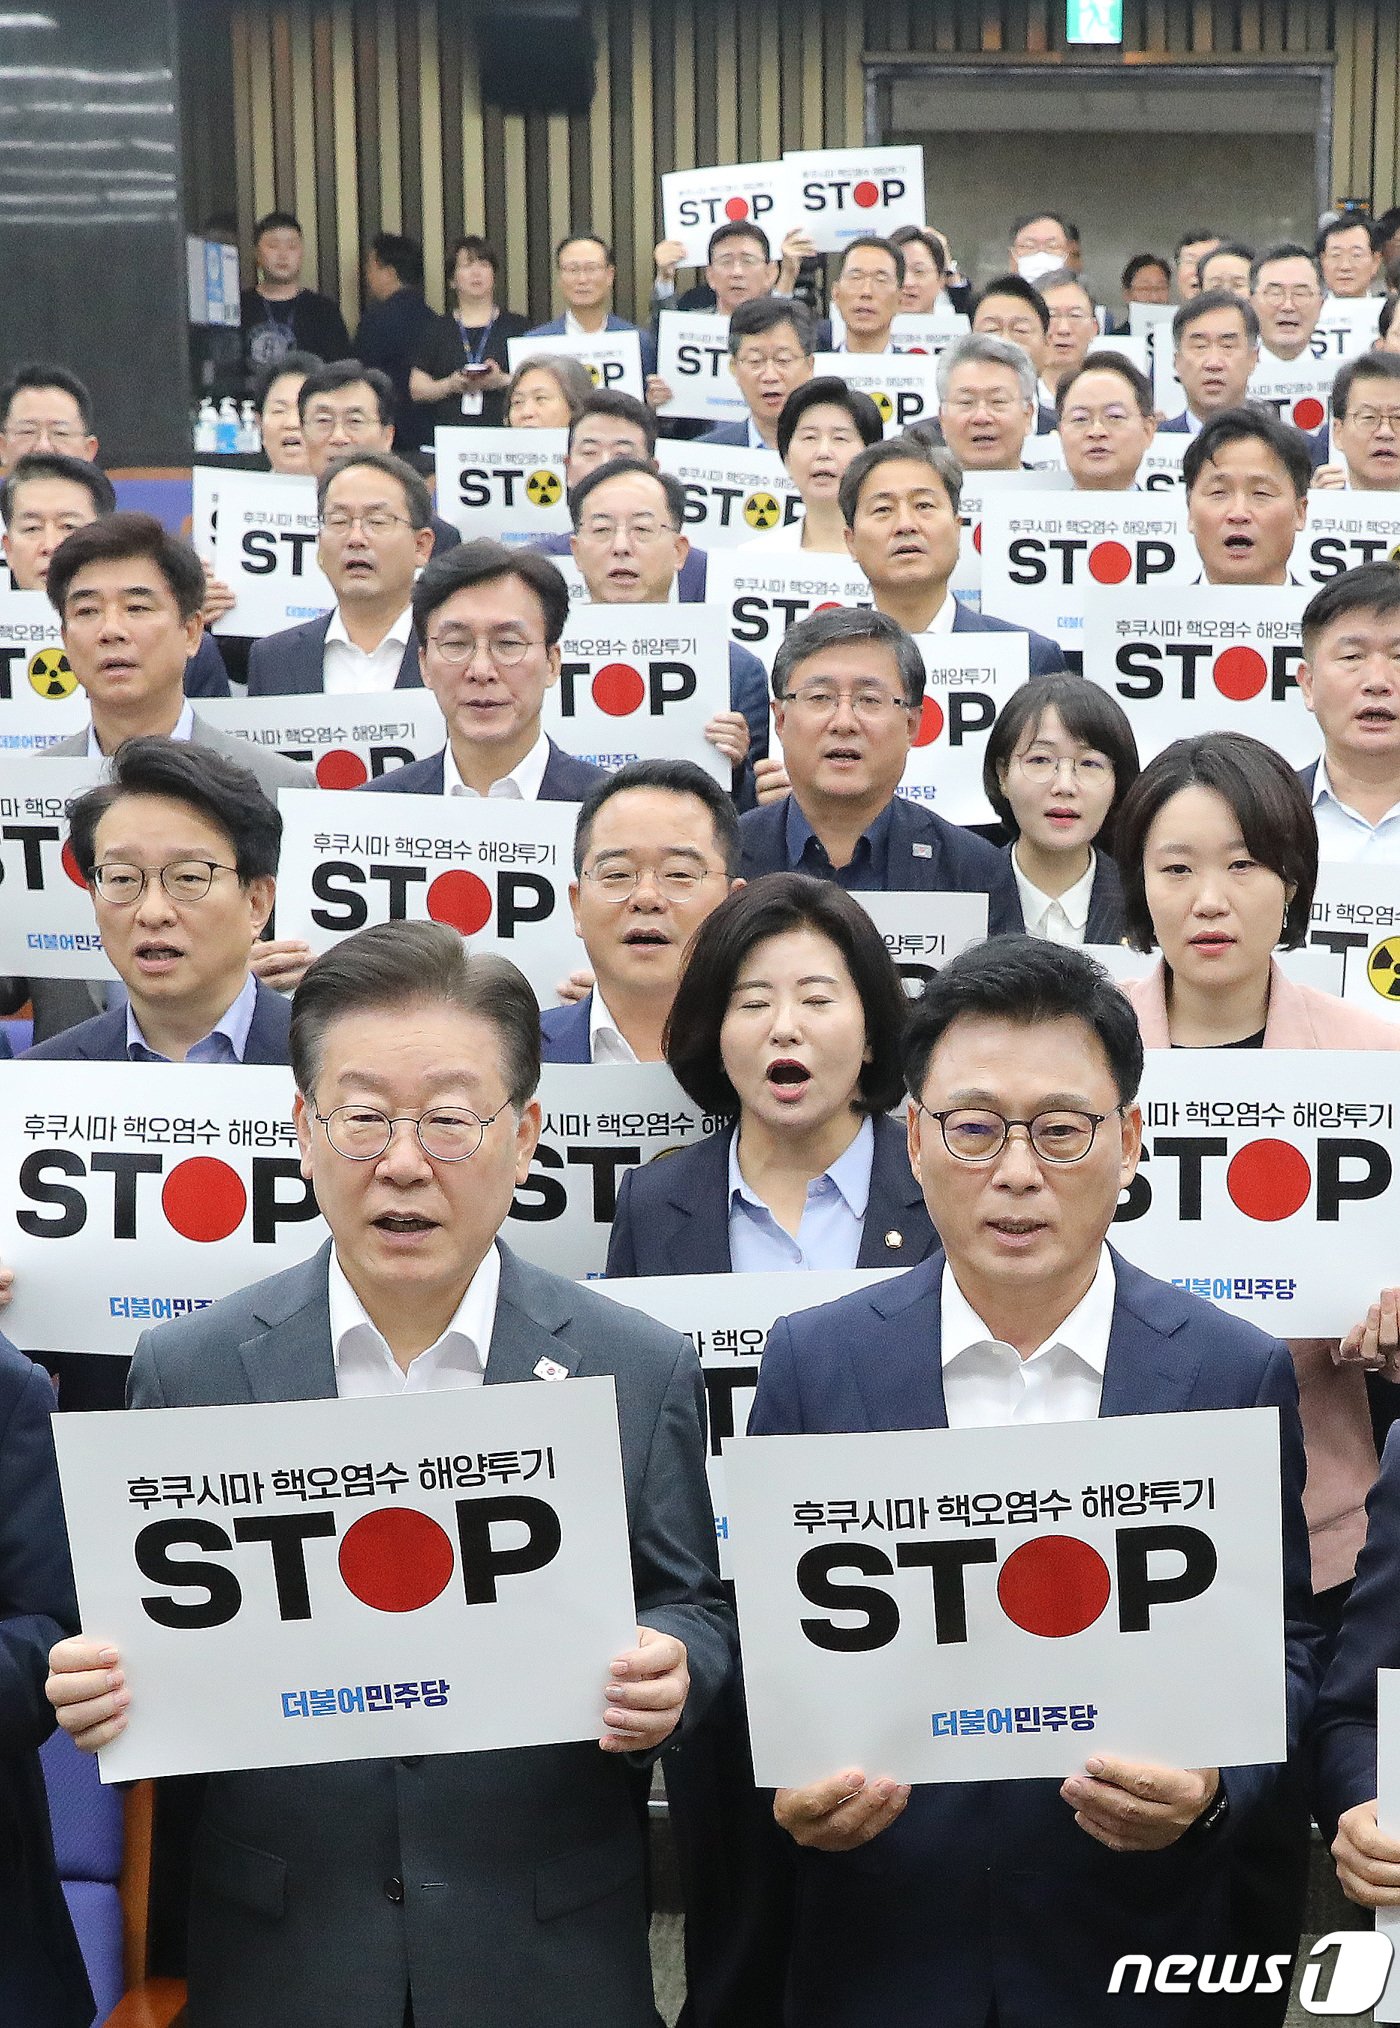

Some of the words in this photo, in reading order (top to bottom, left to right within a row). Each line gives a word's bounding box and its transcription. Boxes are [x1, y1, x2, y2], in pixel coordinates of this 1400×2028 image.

[680, 194, 774, 226] STOP
[803, 179, 905, 210] STOP
[1009, 539, 1175, 584] STOP
[632, 638, 697, 656] 해양투기
[1115, 620, 1181, 637] 후쿠시마
[1186, 620, 1251, 638] 핵오염수
[1256, 621, 1302, 639] 해양투
[931, 667, 997, 686] 해양투기
[1115, 642, 1304, 701] STOP
[561, 662, 697, 717] TOP
[313, 832, 390, 857] 후쿠시마
[395, 836, 473, 861] 핵오염수
[478, 840, 556, 866] 해양투기
[311, 861, 555, 939] STOP
[883, 933, 945, 955] 양투기
[24, 1114, 117, 1142] 후쿠시마
[123, 1116, 221, 1145] 핵오염수
[228, 1118, 300, 1148] 해양투
[542, 1112, 591, 1138] 시마
[597, 1112, 694, 1138] 핵오염수
[1186, 1101, 1285, 1128] 핵오염수
[1293, 1102, 1393, 1129] 해양투기
[16, 1149, 322, 1244] STOP
[127, 1476, 265, 1511] 후쿠시마
[271, 1462, 410, 1501] 핵오염수
[418, 1446, 555, 1491] 해양투기
[793, 1498, 930, 1535] 후쿠시마
[936, 1488, 1073, 1529] 핵오염수
[1081, 1477, 1216, 1520] 해양투기
[134, 1495, 562, 1630] STOP
[796, 1525, 1218, 1653] STOP
[281, 1680, 451, 1719] 더불어민주당
[931, 1703, 1098, 1738] 더불어민주당
